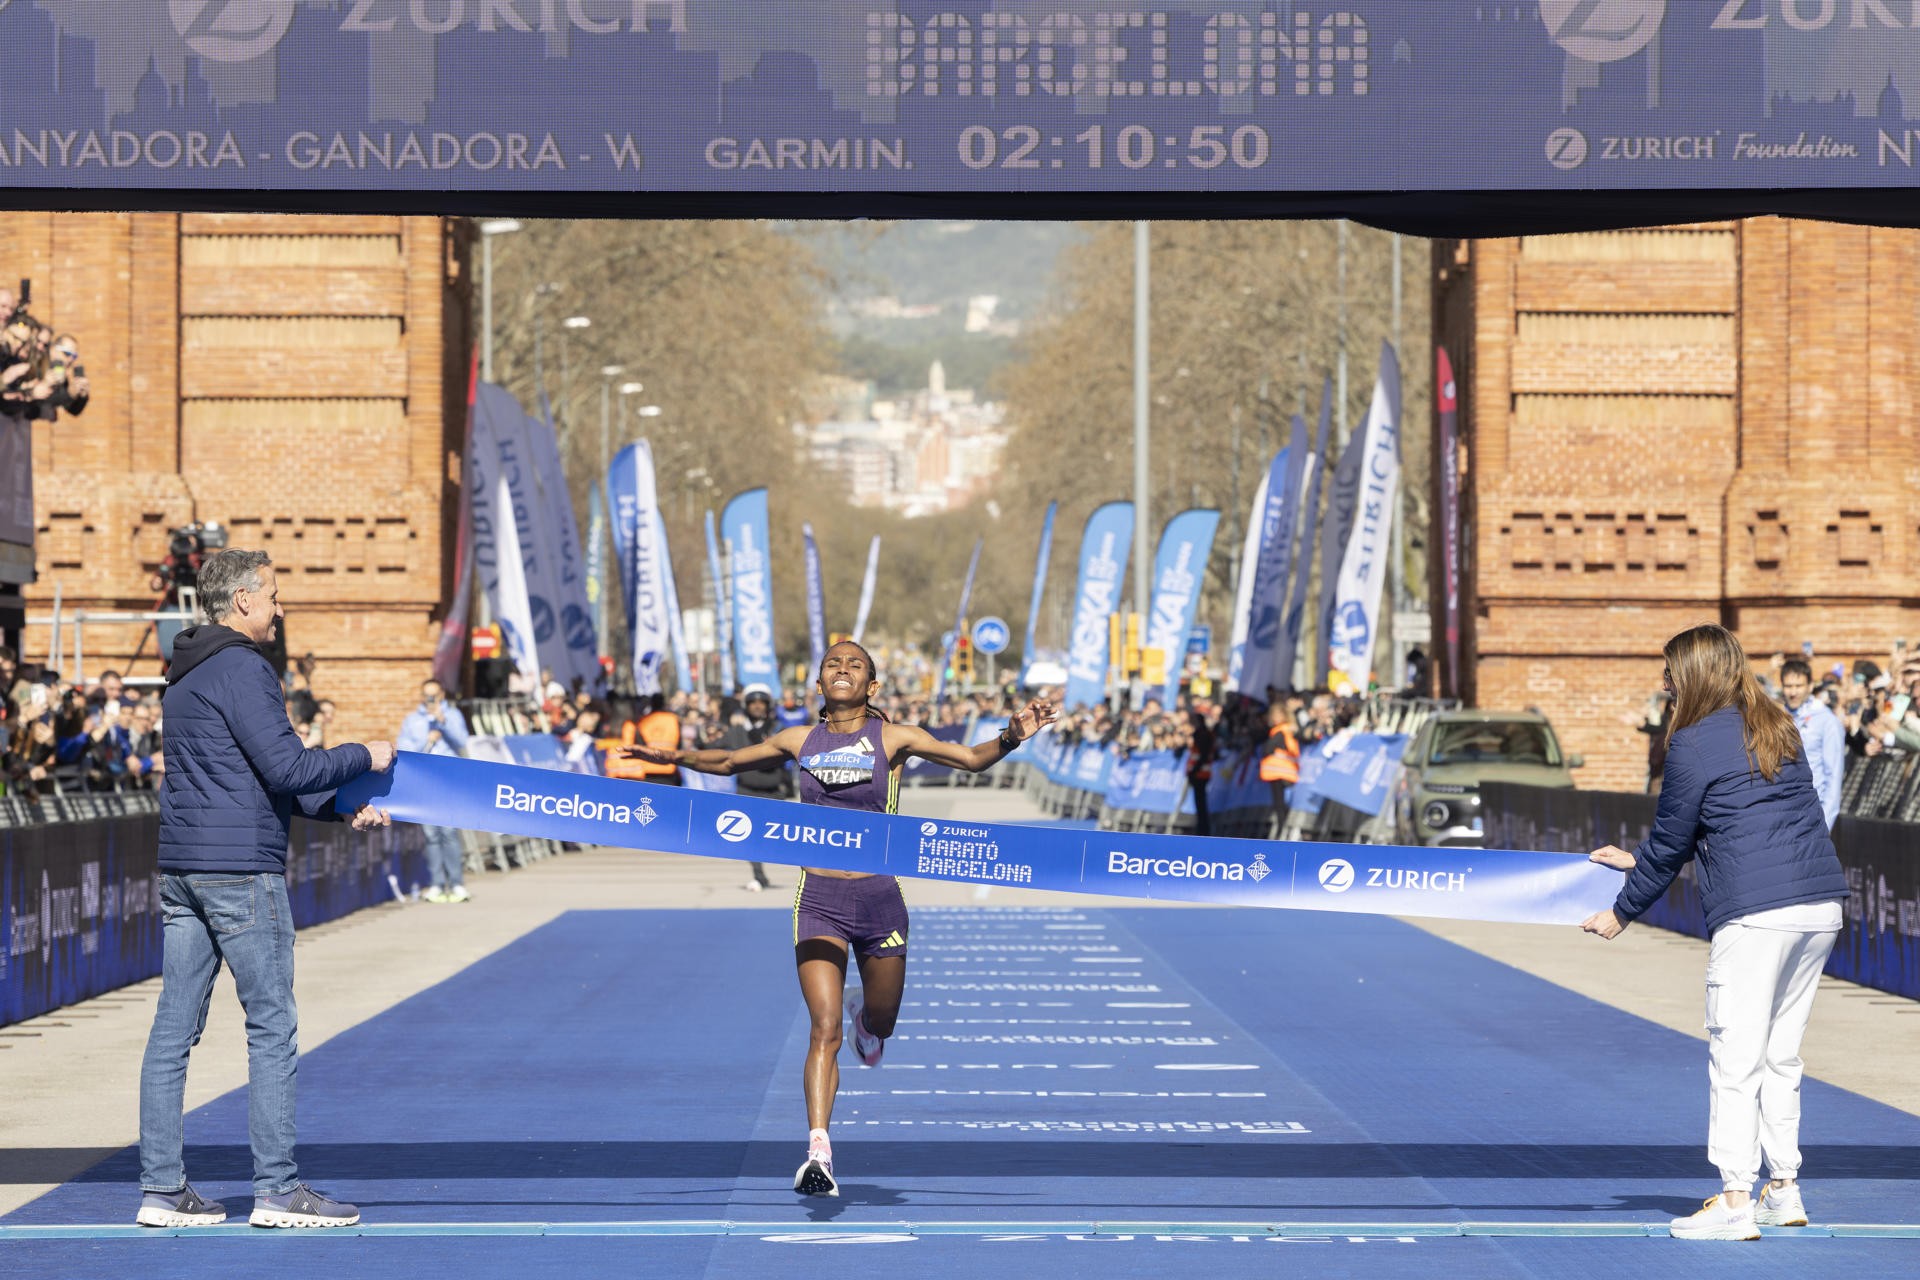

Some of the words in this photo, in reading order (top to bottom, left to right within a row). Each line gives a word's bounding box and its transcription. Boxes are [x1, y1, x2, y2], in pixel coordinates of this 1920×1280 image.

[865, 12, 1368, 97] BARCELONA
[286, 130, 566, 170] GANADORA
[958, 125, 1270, 170] 02:10:50
[1600, 136, 1715, 160] ZURICH
[1732, 132, 1859, 161] Foundation
[823, 754, 860, 764] ZURICH
[495, 783, 630, 824] Barcelona
[764, 822, 862, 849] ZURICH
[942, 826, 988, 838] ZURICH
[919, 837, 999, 861] MARATÓ
[917, 856, 1032, 884] BARCELONA
[1108, 851, 1244, 881] Barcelona
[1366, 867, 1466, 892] ZURICH
